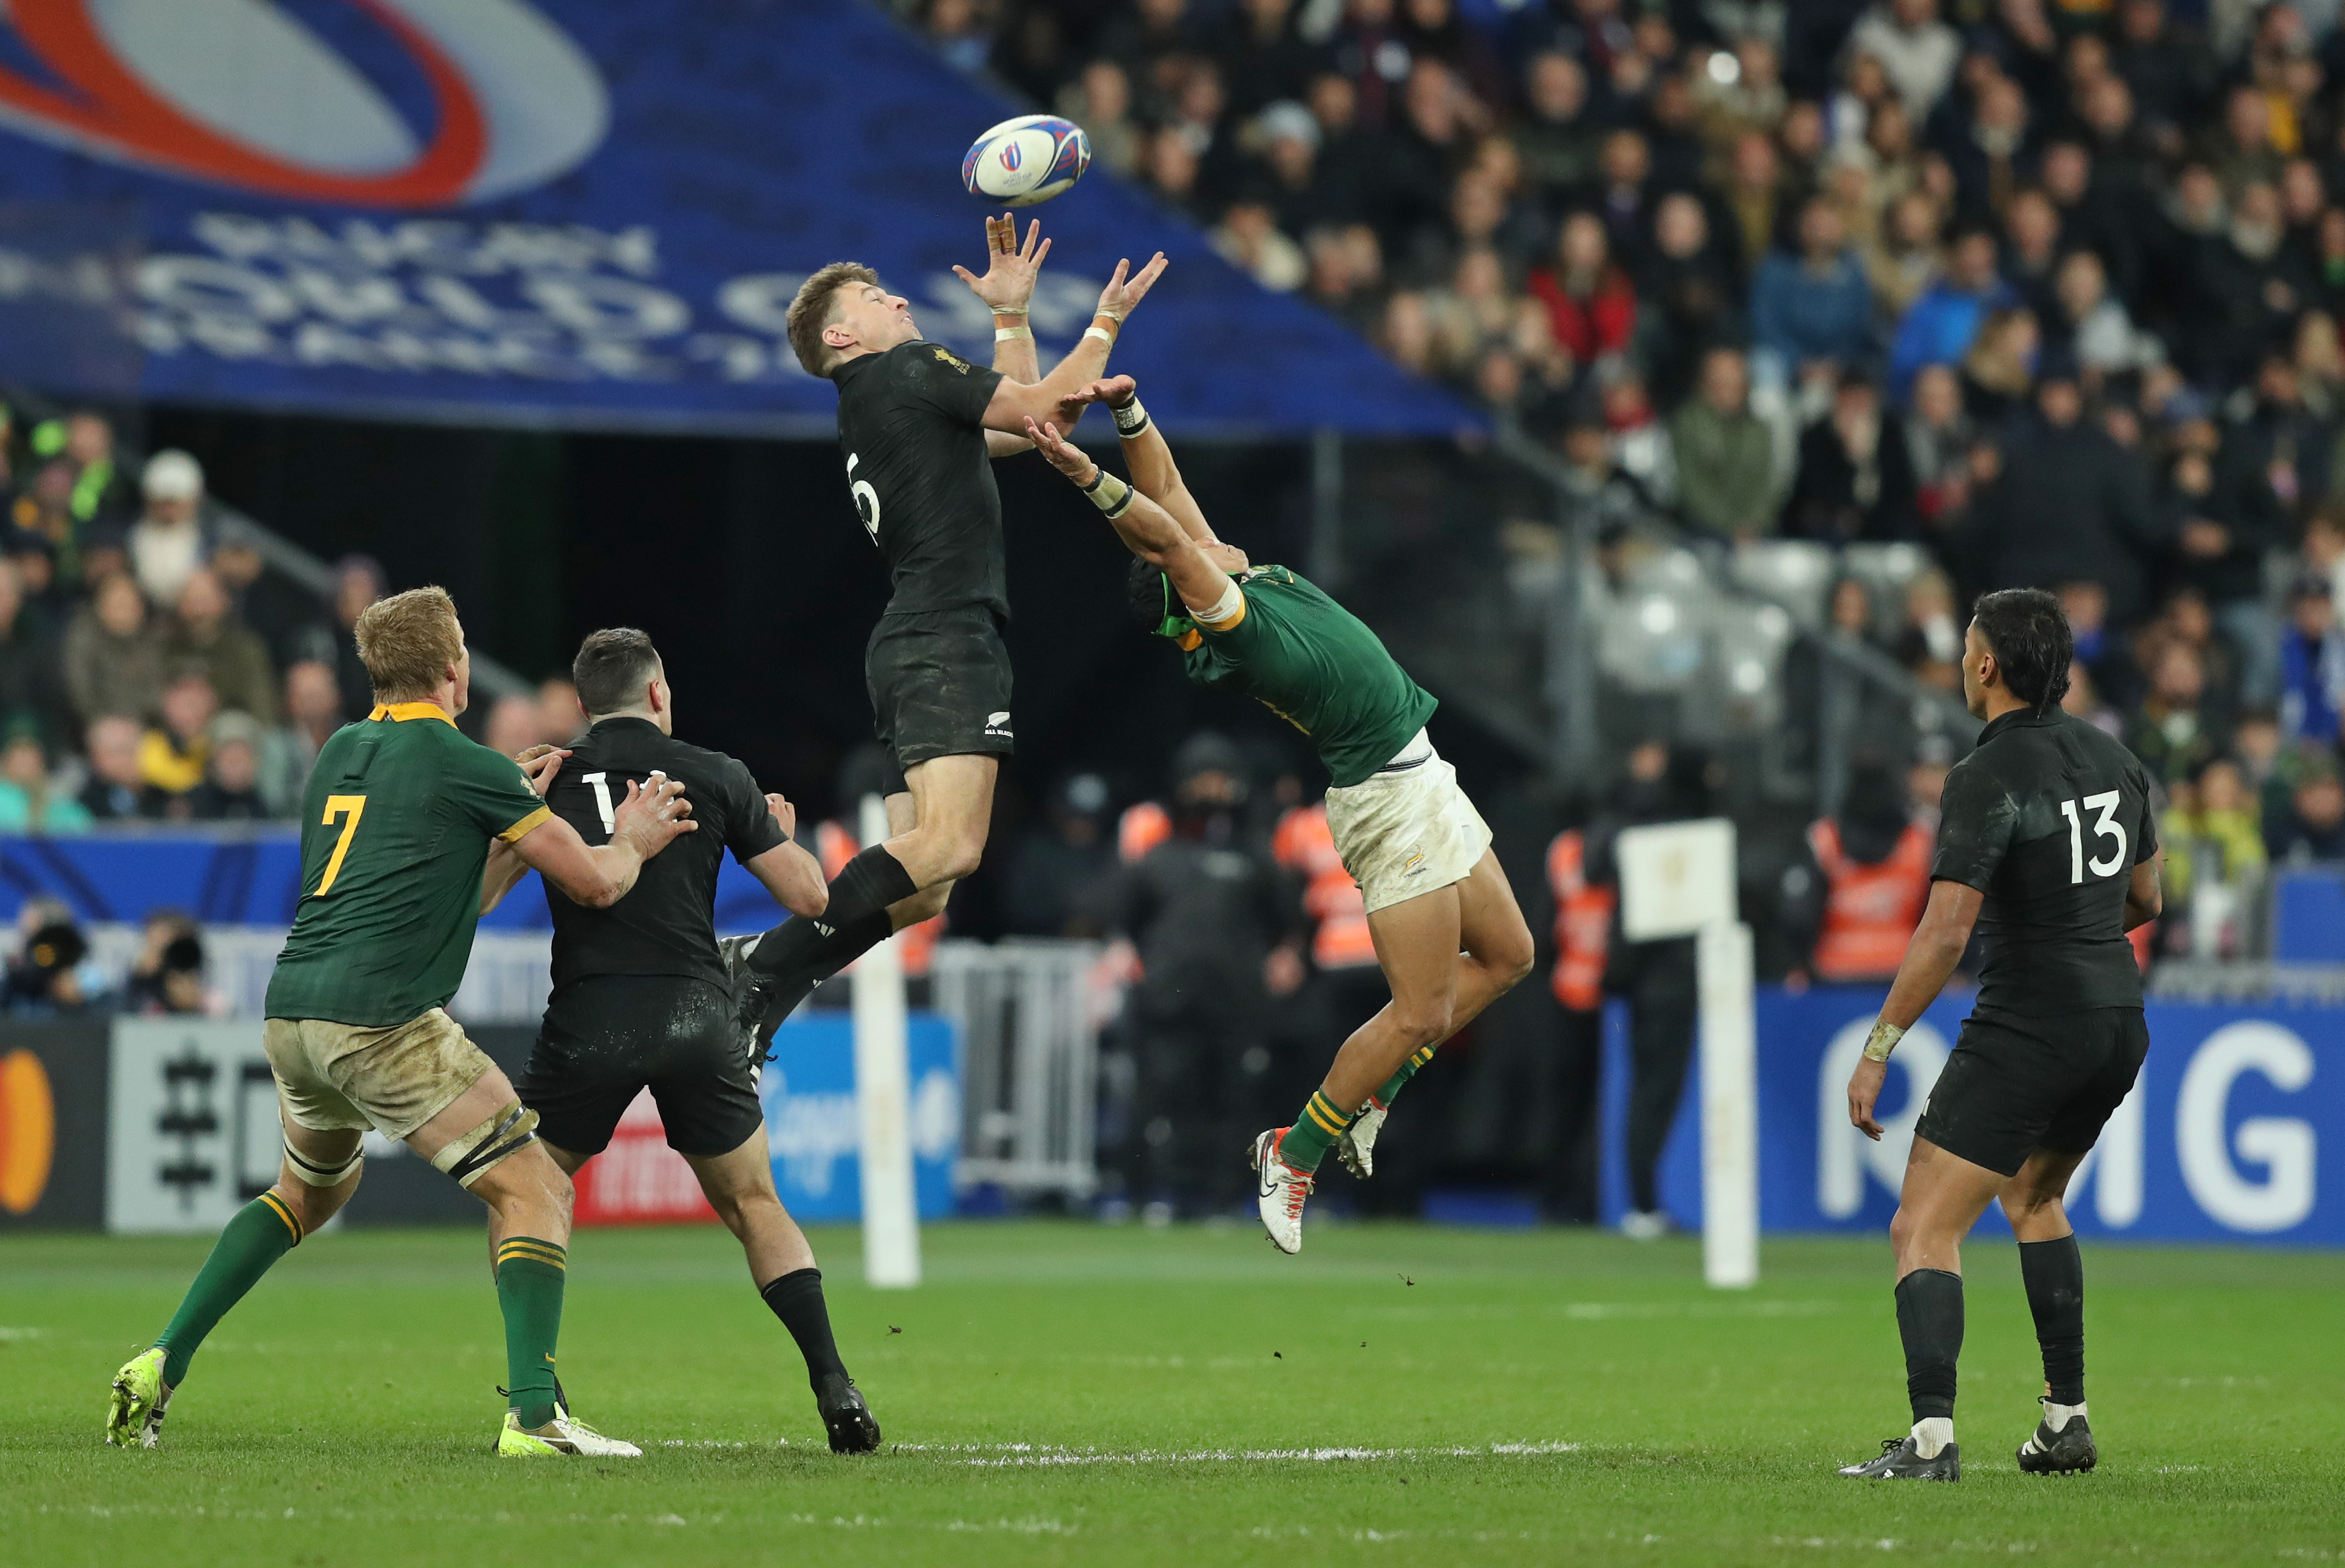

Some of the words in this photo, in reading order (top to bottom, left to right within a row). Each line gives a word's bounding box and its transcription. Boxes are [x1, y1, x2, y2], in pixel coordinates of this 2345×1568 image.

[312, 795, 368, 897] 7
[581, 769, 678, 835] 1
[2061, 790, 2127, 884] 13
